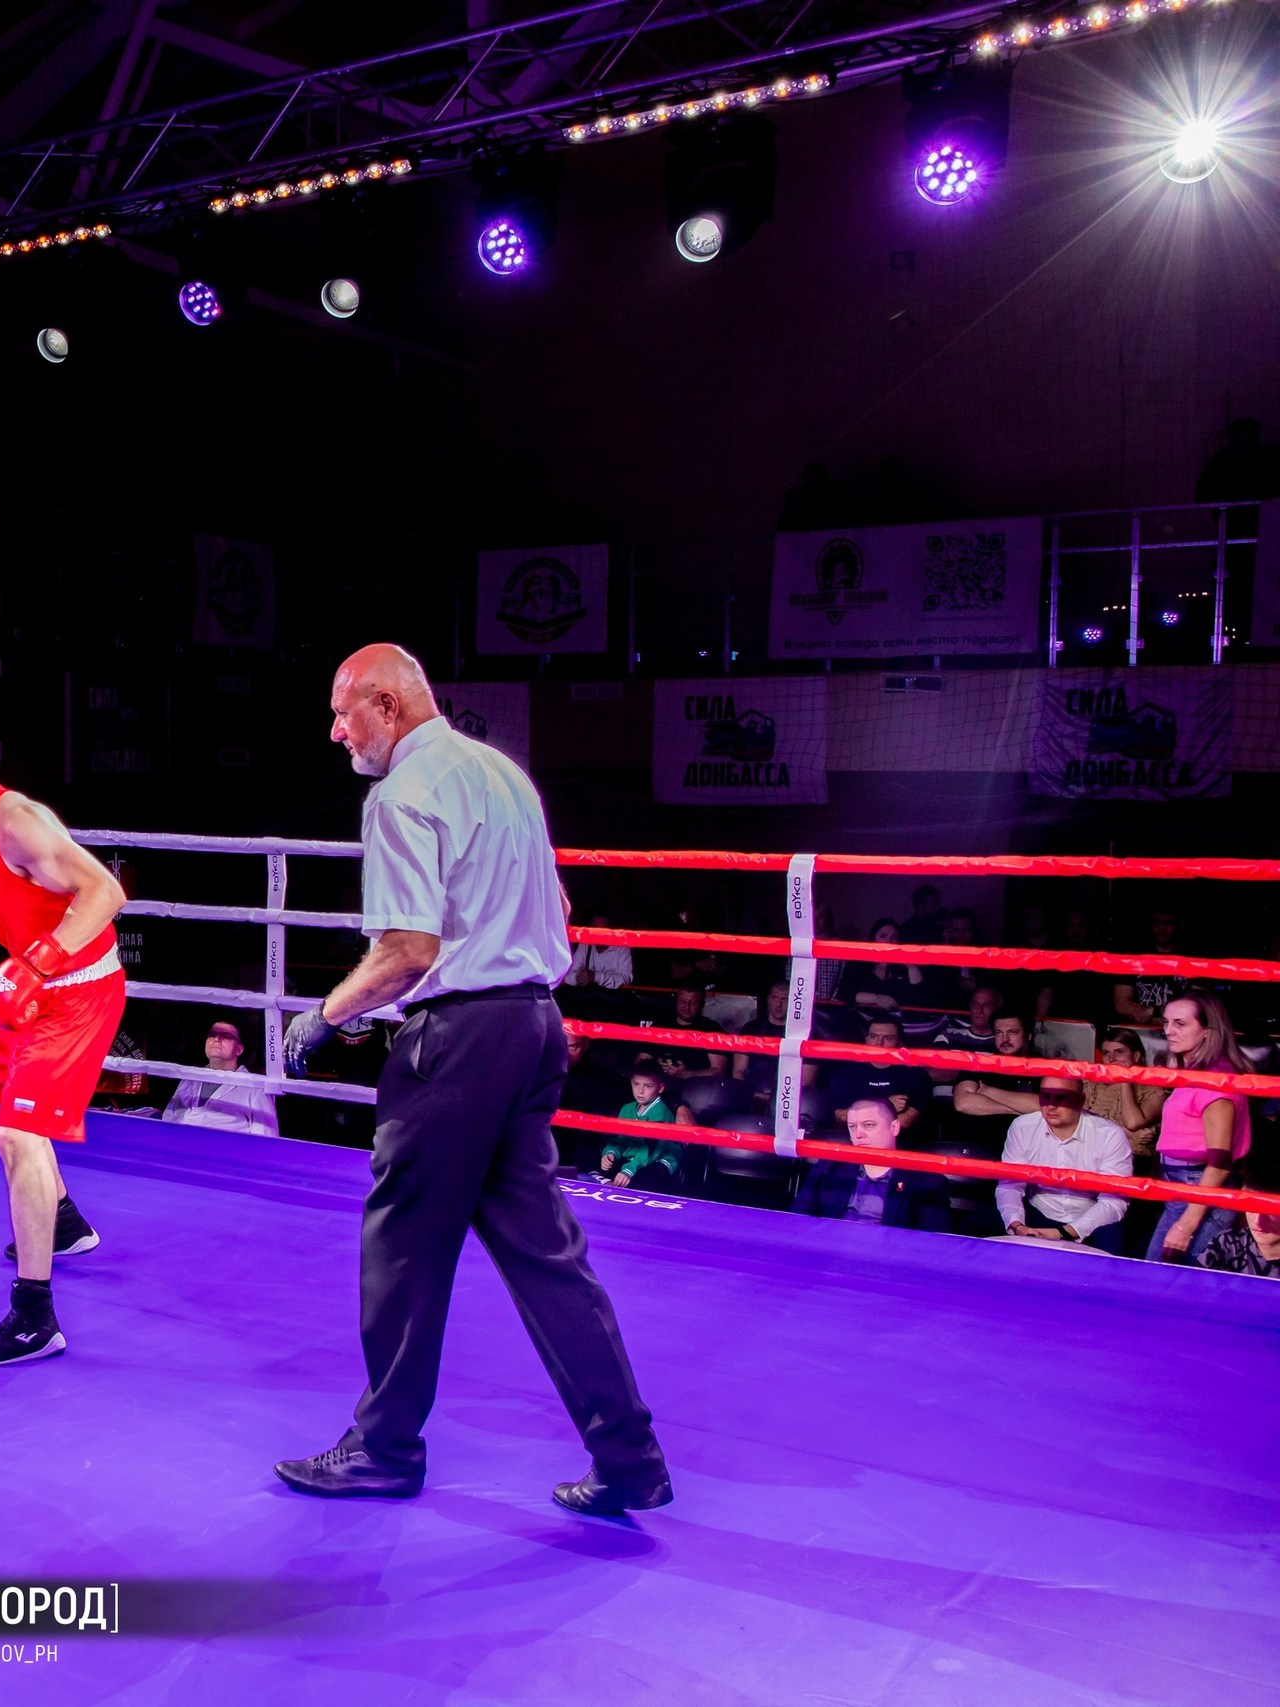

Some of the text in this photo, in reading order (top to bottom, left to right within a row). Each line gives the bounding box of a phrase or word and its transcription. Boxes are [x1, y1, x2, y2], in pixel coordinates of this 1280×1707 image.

[684, 695, 736, 720] СИЛА
[1066, 688, 1129, 714] СИЛА
[683, 762, 791, 788] ДОНБАССА
[1064, 760, 1192, 787] ДОНБАССА
[793, 977, 805, 1020] BOYKO
[782, 1075, 792, 1120] BOYKO
